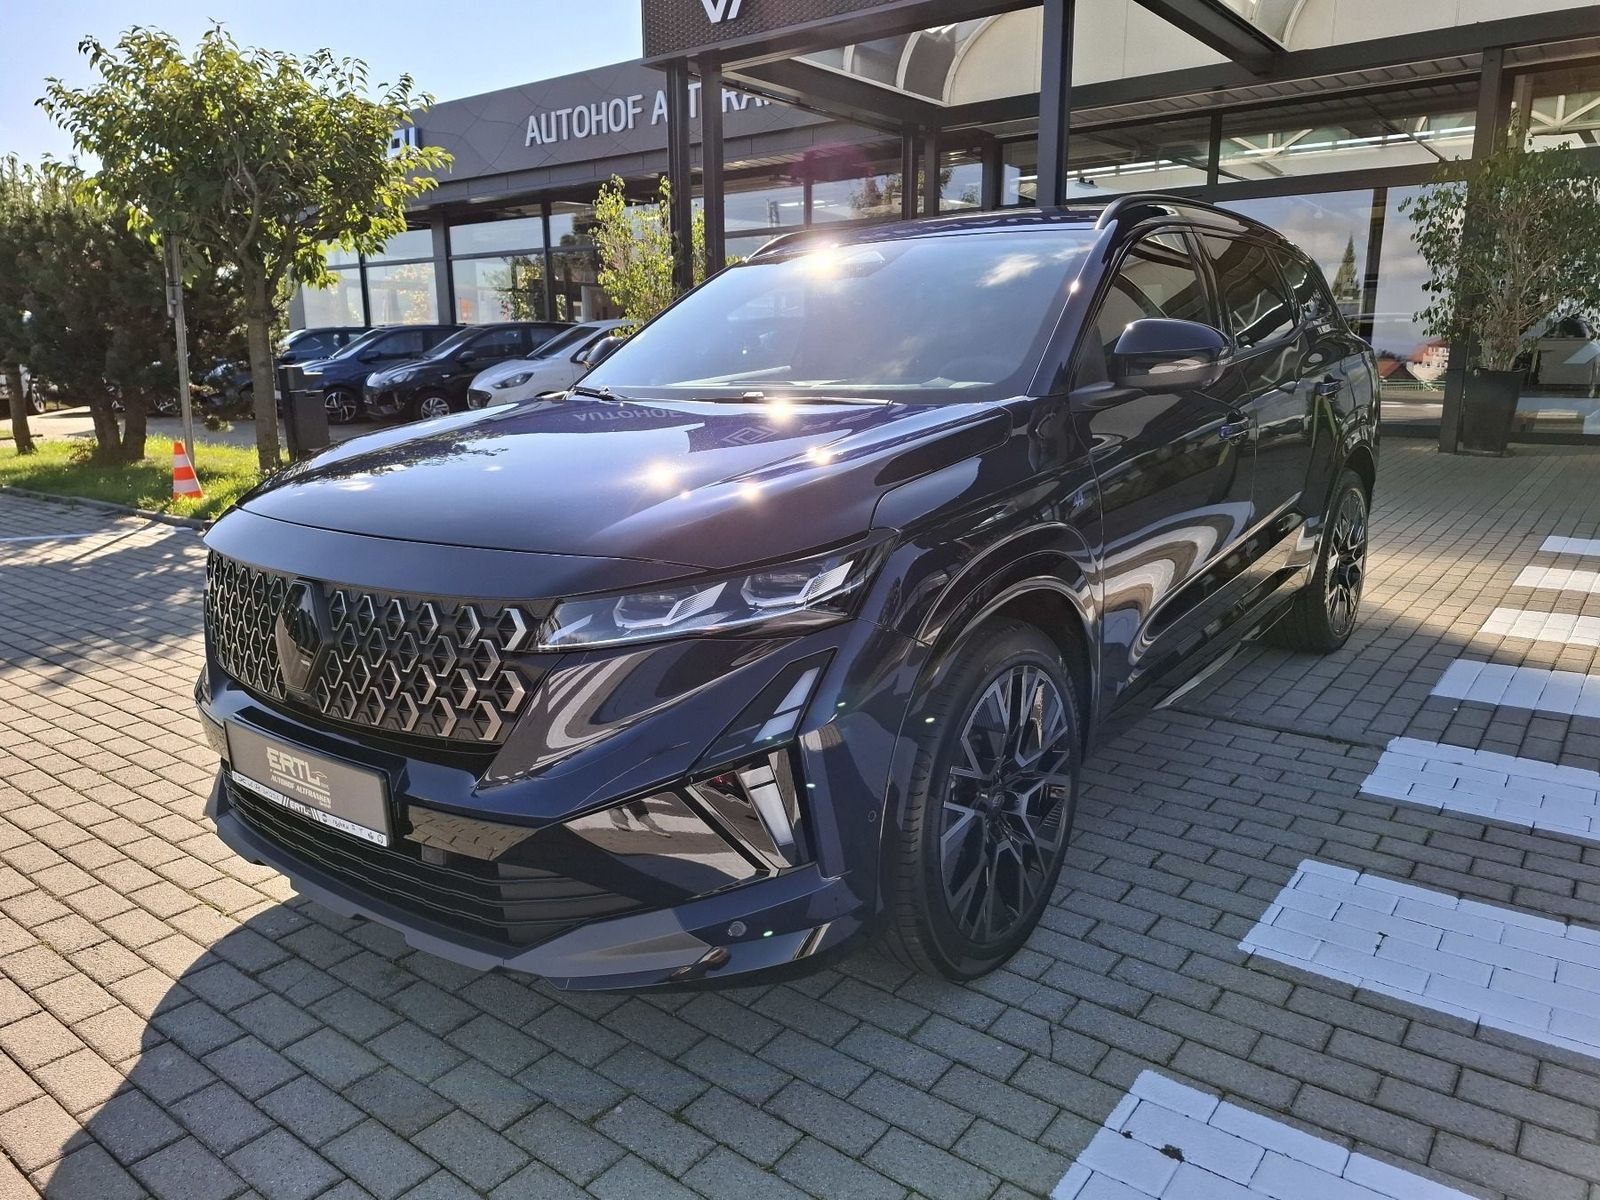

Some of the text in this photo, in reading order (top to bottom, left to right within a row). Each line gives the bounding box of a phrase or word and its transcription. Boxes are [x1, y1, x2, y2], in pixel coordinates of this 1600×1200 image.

[525, 94, 643, 147] AUTOHOF
[266, 746, 321, 786] ERTL
[289, 800, 311, 816] ERTL
